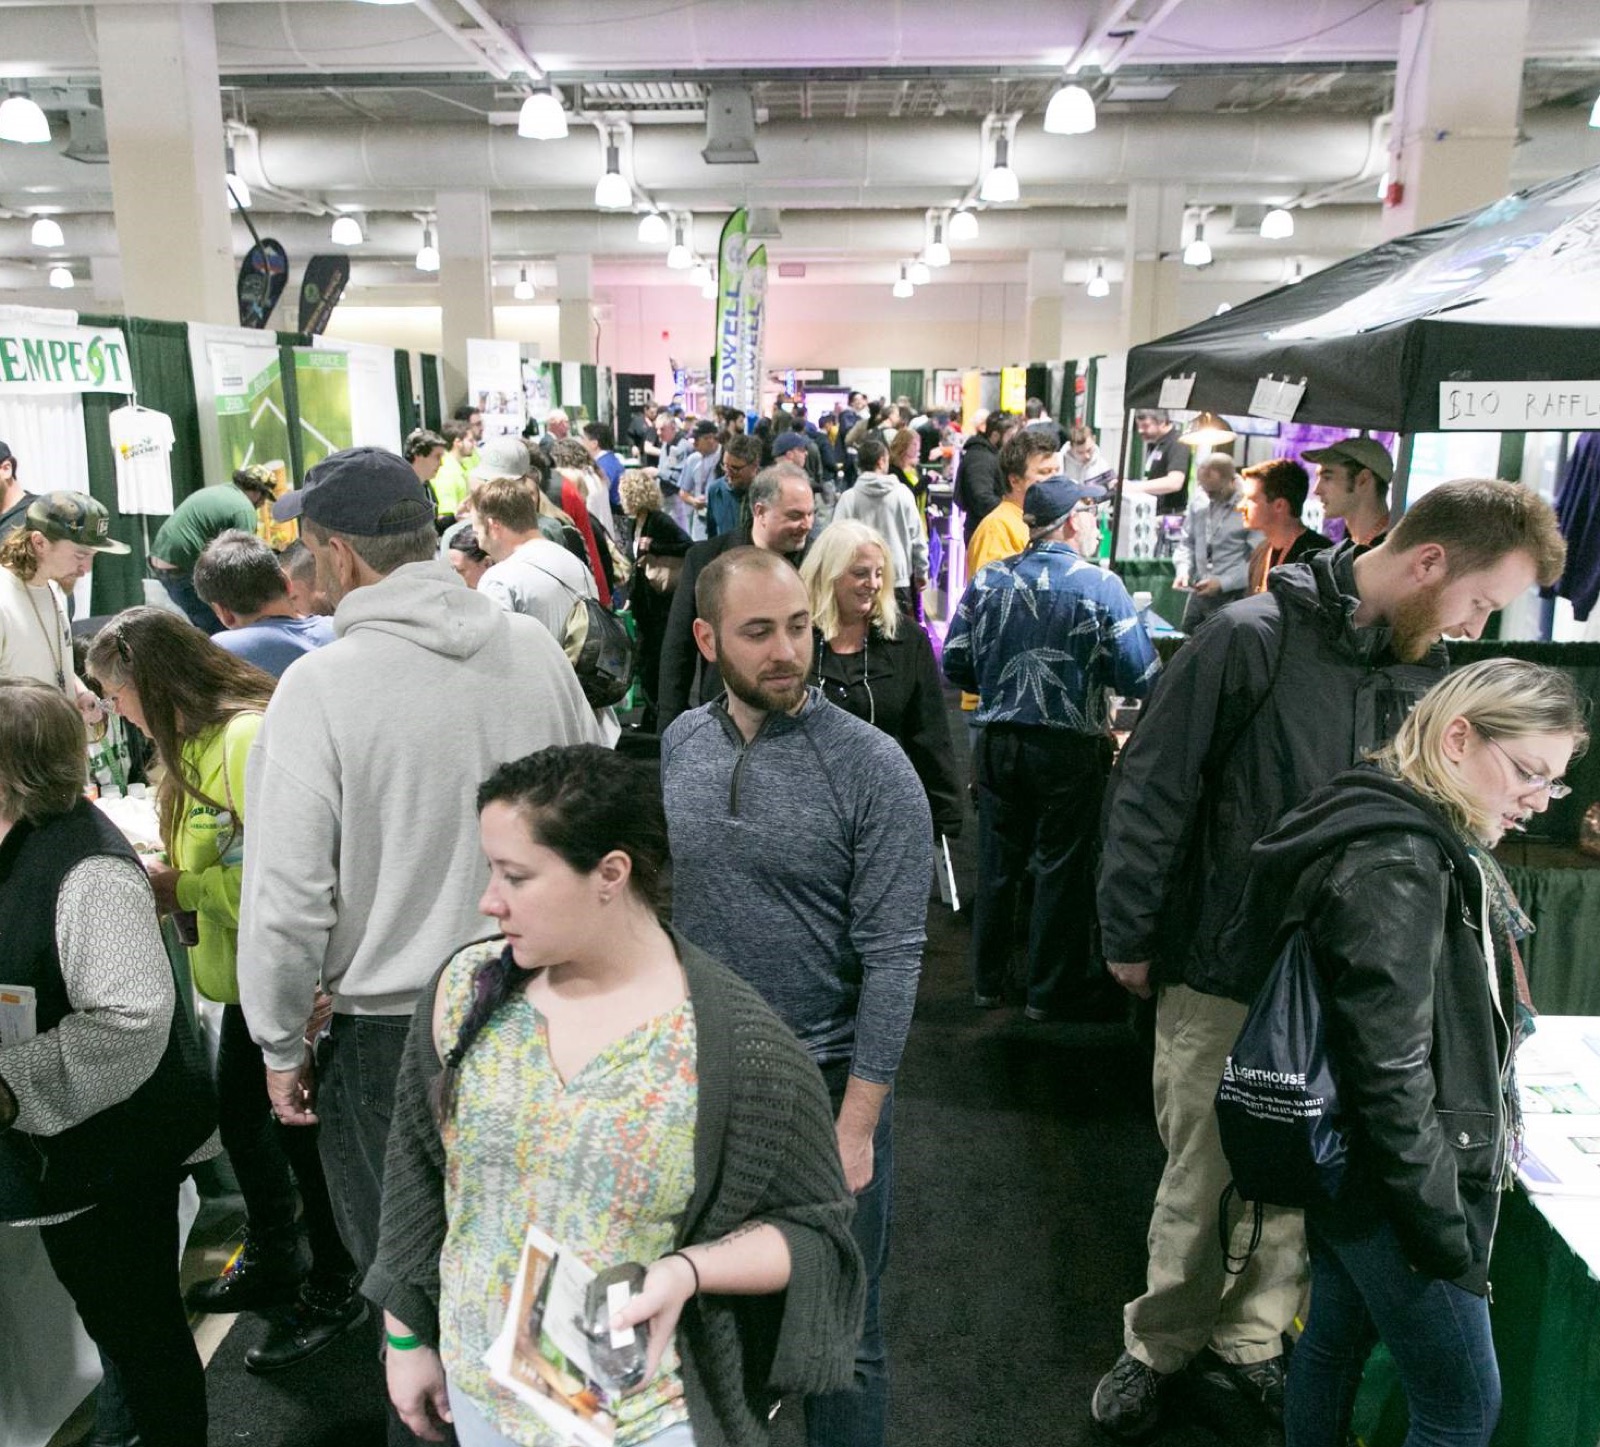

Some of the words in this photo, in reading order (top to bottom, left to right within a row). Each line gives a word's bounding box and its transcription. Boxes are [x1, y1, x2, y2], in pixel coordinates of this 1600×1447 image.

[0, 336, 123, 386] EMPEST
[1447, 390, 1500, 420] $10
[1525, 392, 1600, 421] RAFFL
[1234, 1064, 1306, 1085] LGHTHOUSE
